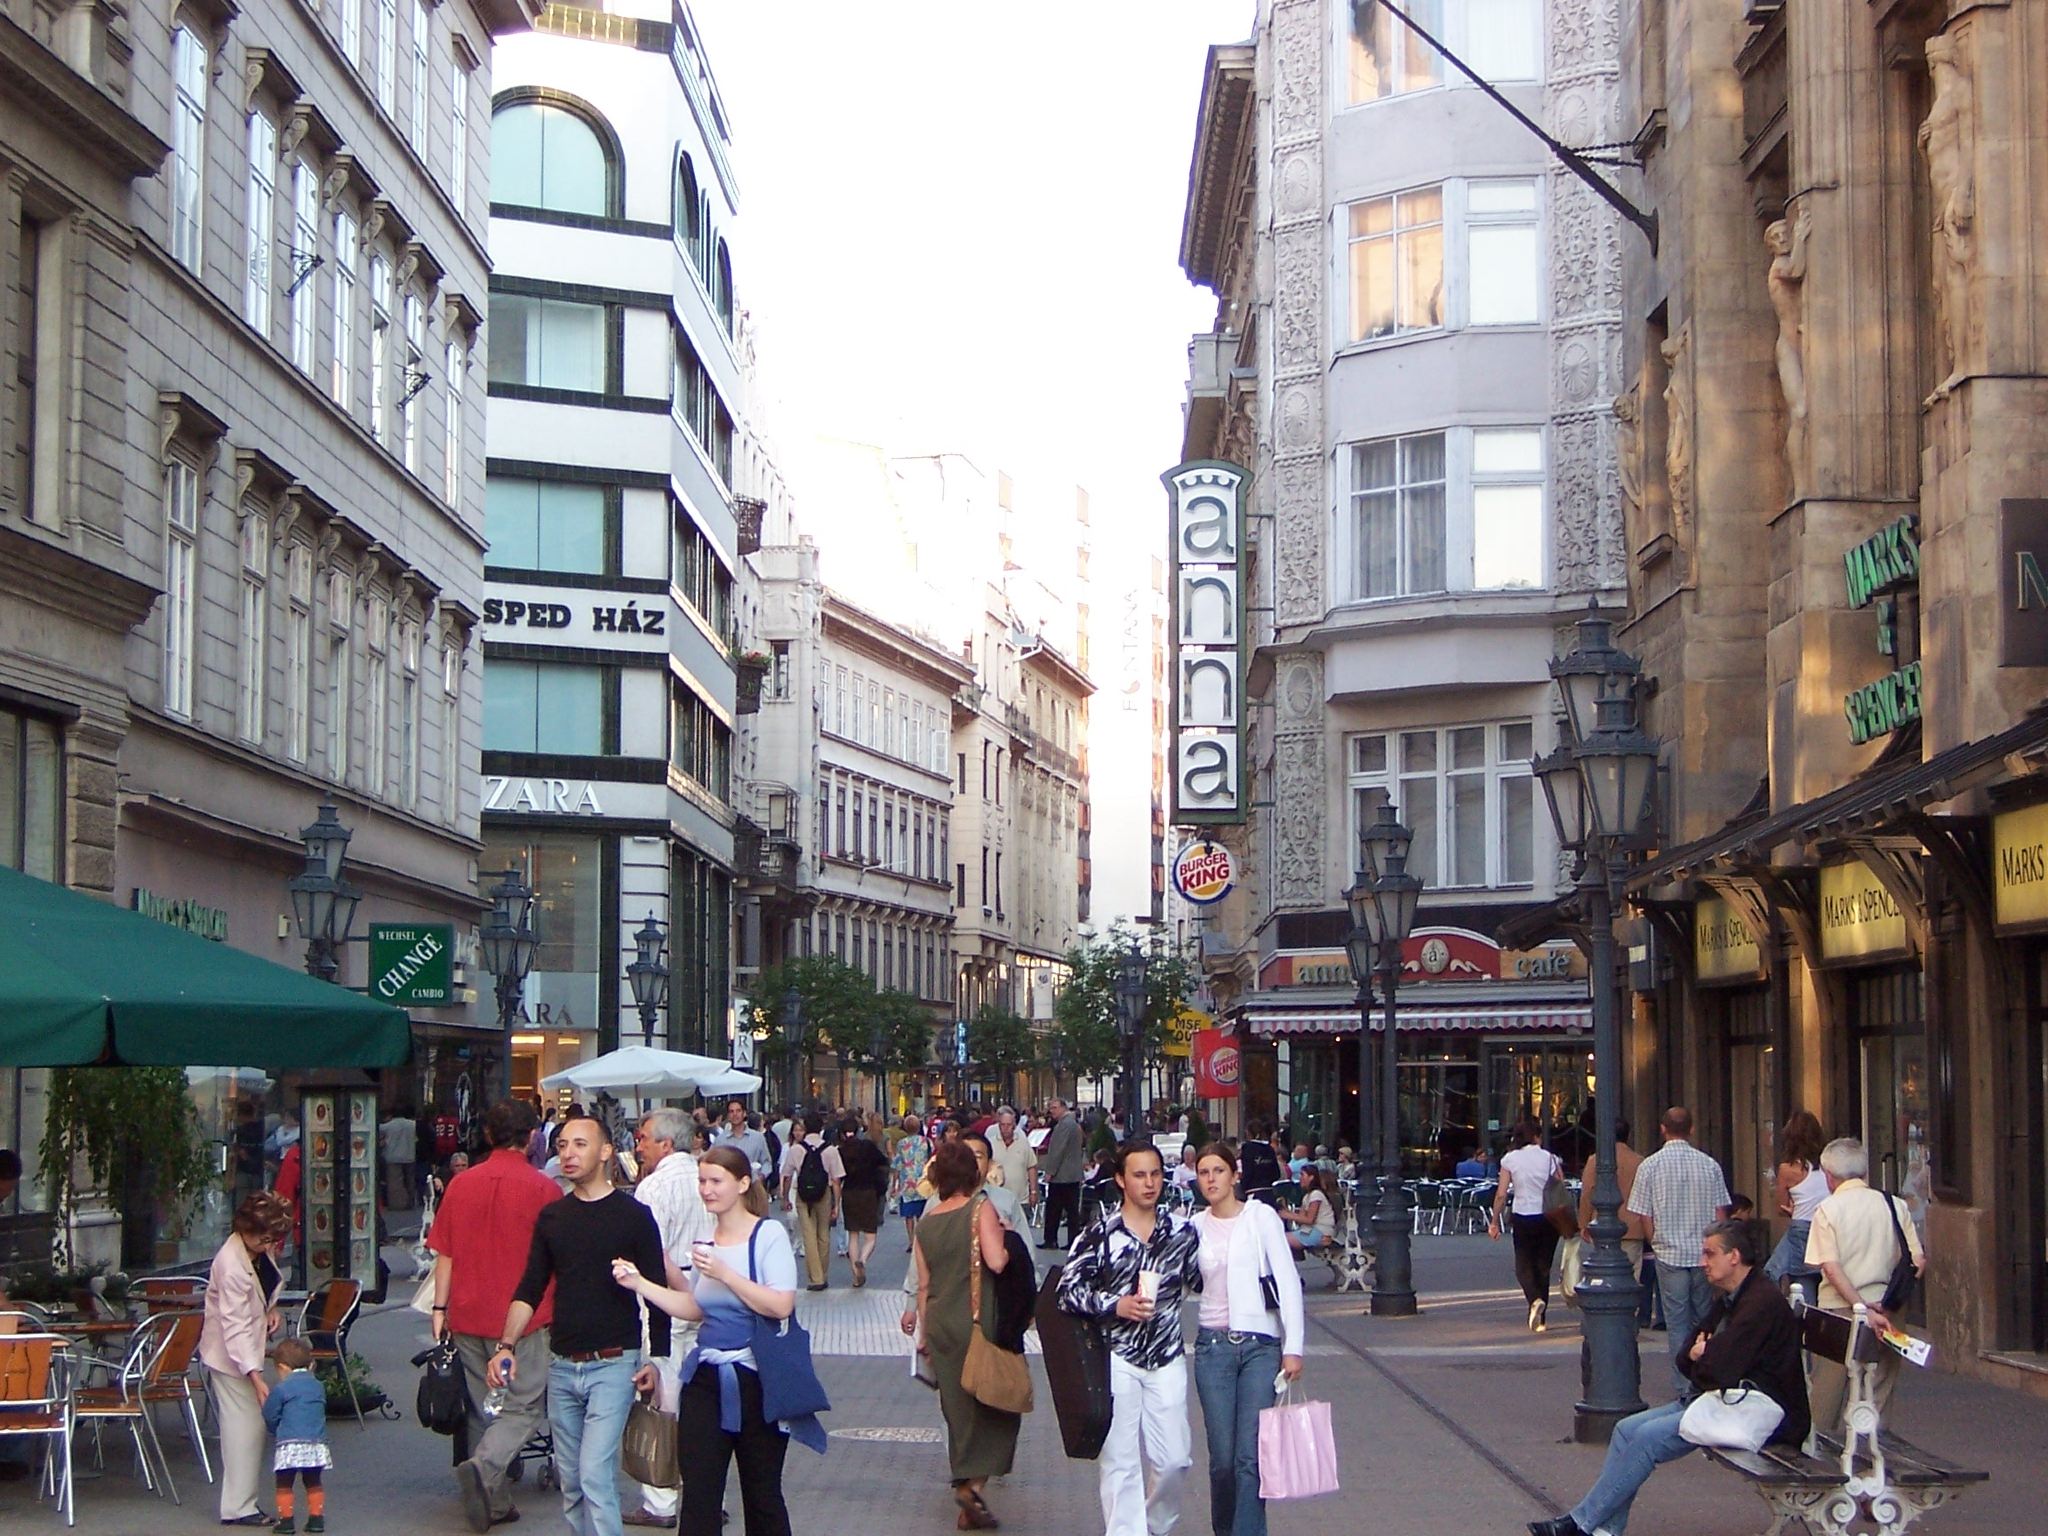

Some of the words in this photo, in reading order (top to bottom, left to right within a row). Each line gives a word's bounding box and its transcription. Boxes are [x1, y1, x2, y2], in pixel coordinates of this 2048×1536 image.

[1843, 514, 1919, 610] MARKS
[483, 597, 572, 629] SPED
[592, 600, 665, 636] HÁZ
[484, 775, 604, 816] ZARA
[1180, 852, 1227, 877] BURGER
[1182, 864, 1229, 892] KING
[2002, 844, 2045, 888] MARKS
[1824, 894, 1855, 929] MARKS
[378, 931, 416, 941] WECHSEL
[377, 932, 443, 998] CHANGE
[1297, 963, 1350, 985] ann
[1515, 950, 1570, 977] café
[411, 988, 444, 999] CAMBIO
